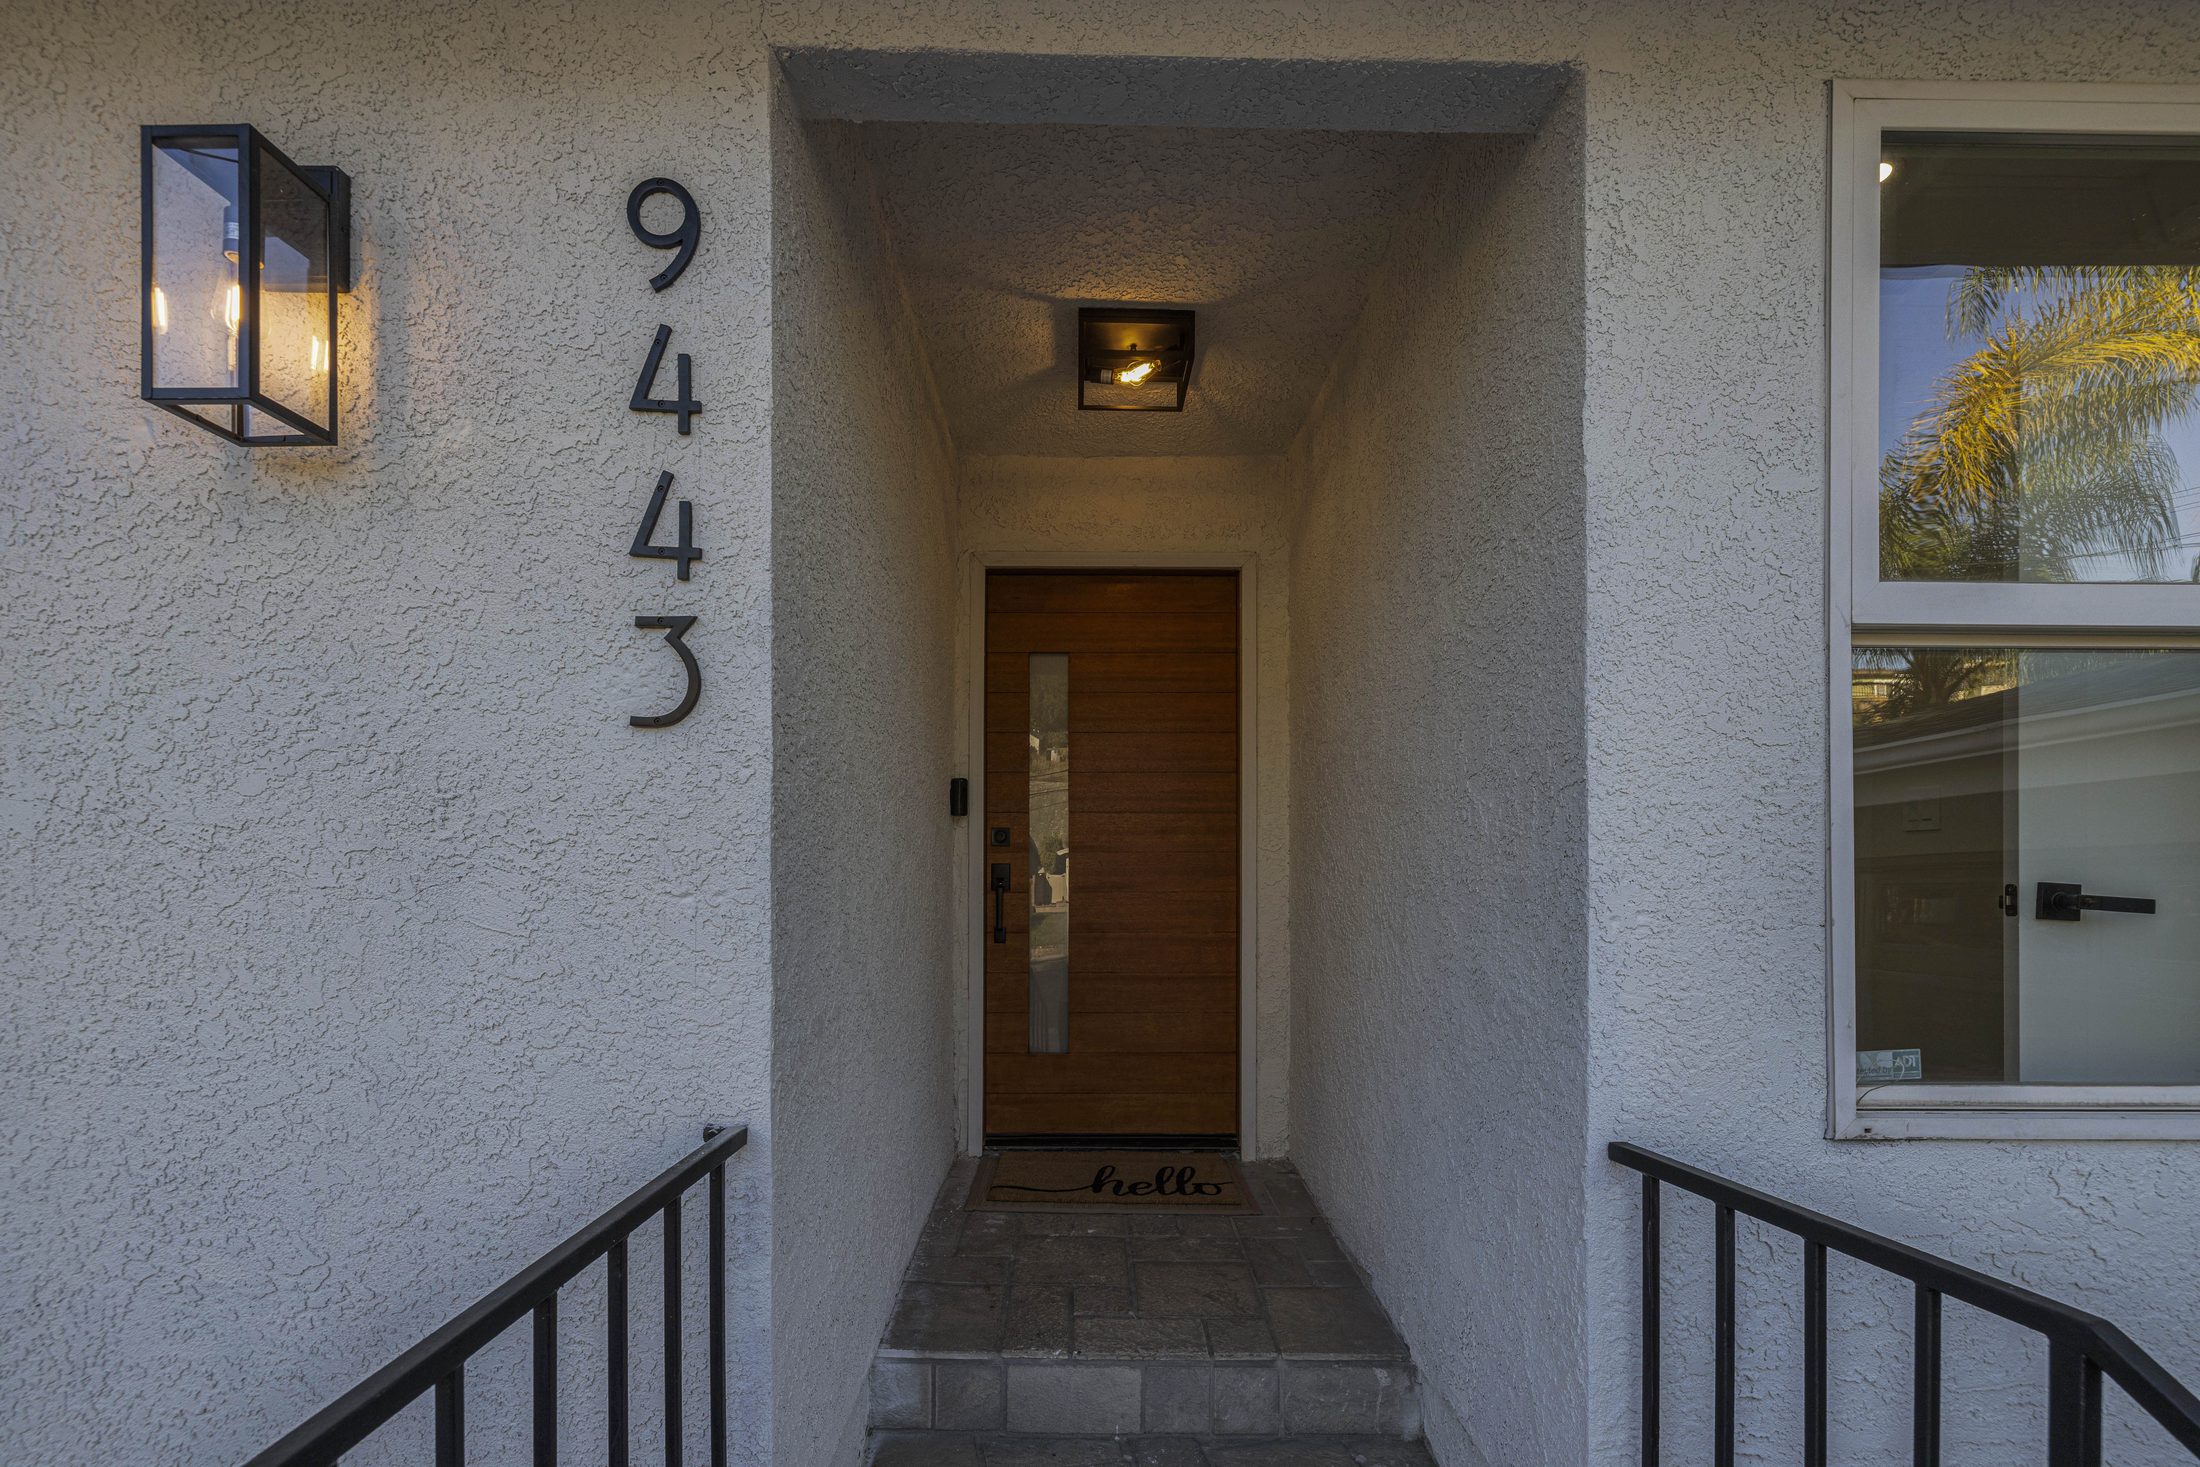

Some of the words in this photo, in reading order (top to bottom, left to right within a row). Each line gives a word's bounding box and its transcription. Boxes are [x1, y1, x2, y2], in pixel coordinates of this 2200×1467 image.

[626, 177, 703, 727] 9443
[1894, 1055, 1916, 1068] ADT
[1089, 1165, 1233, 1196] hello
